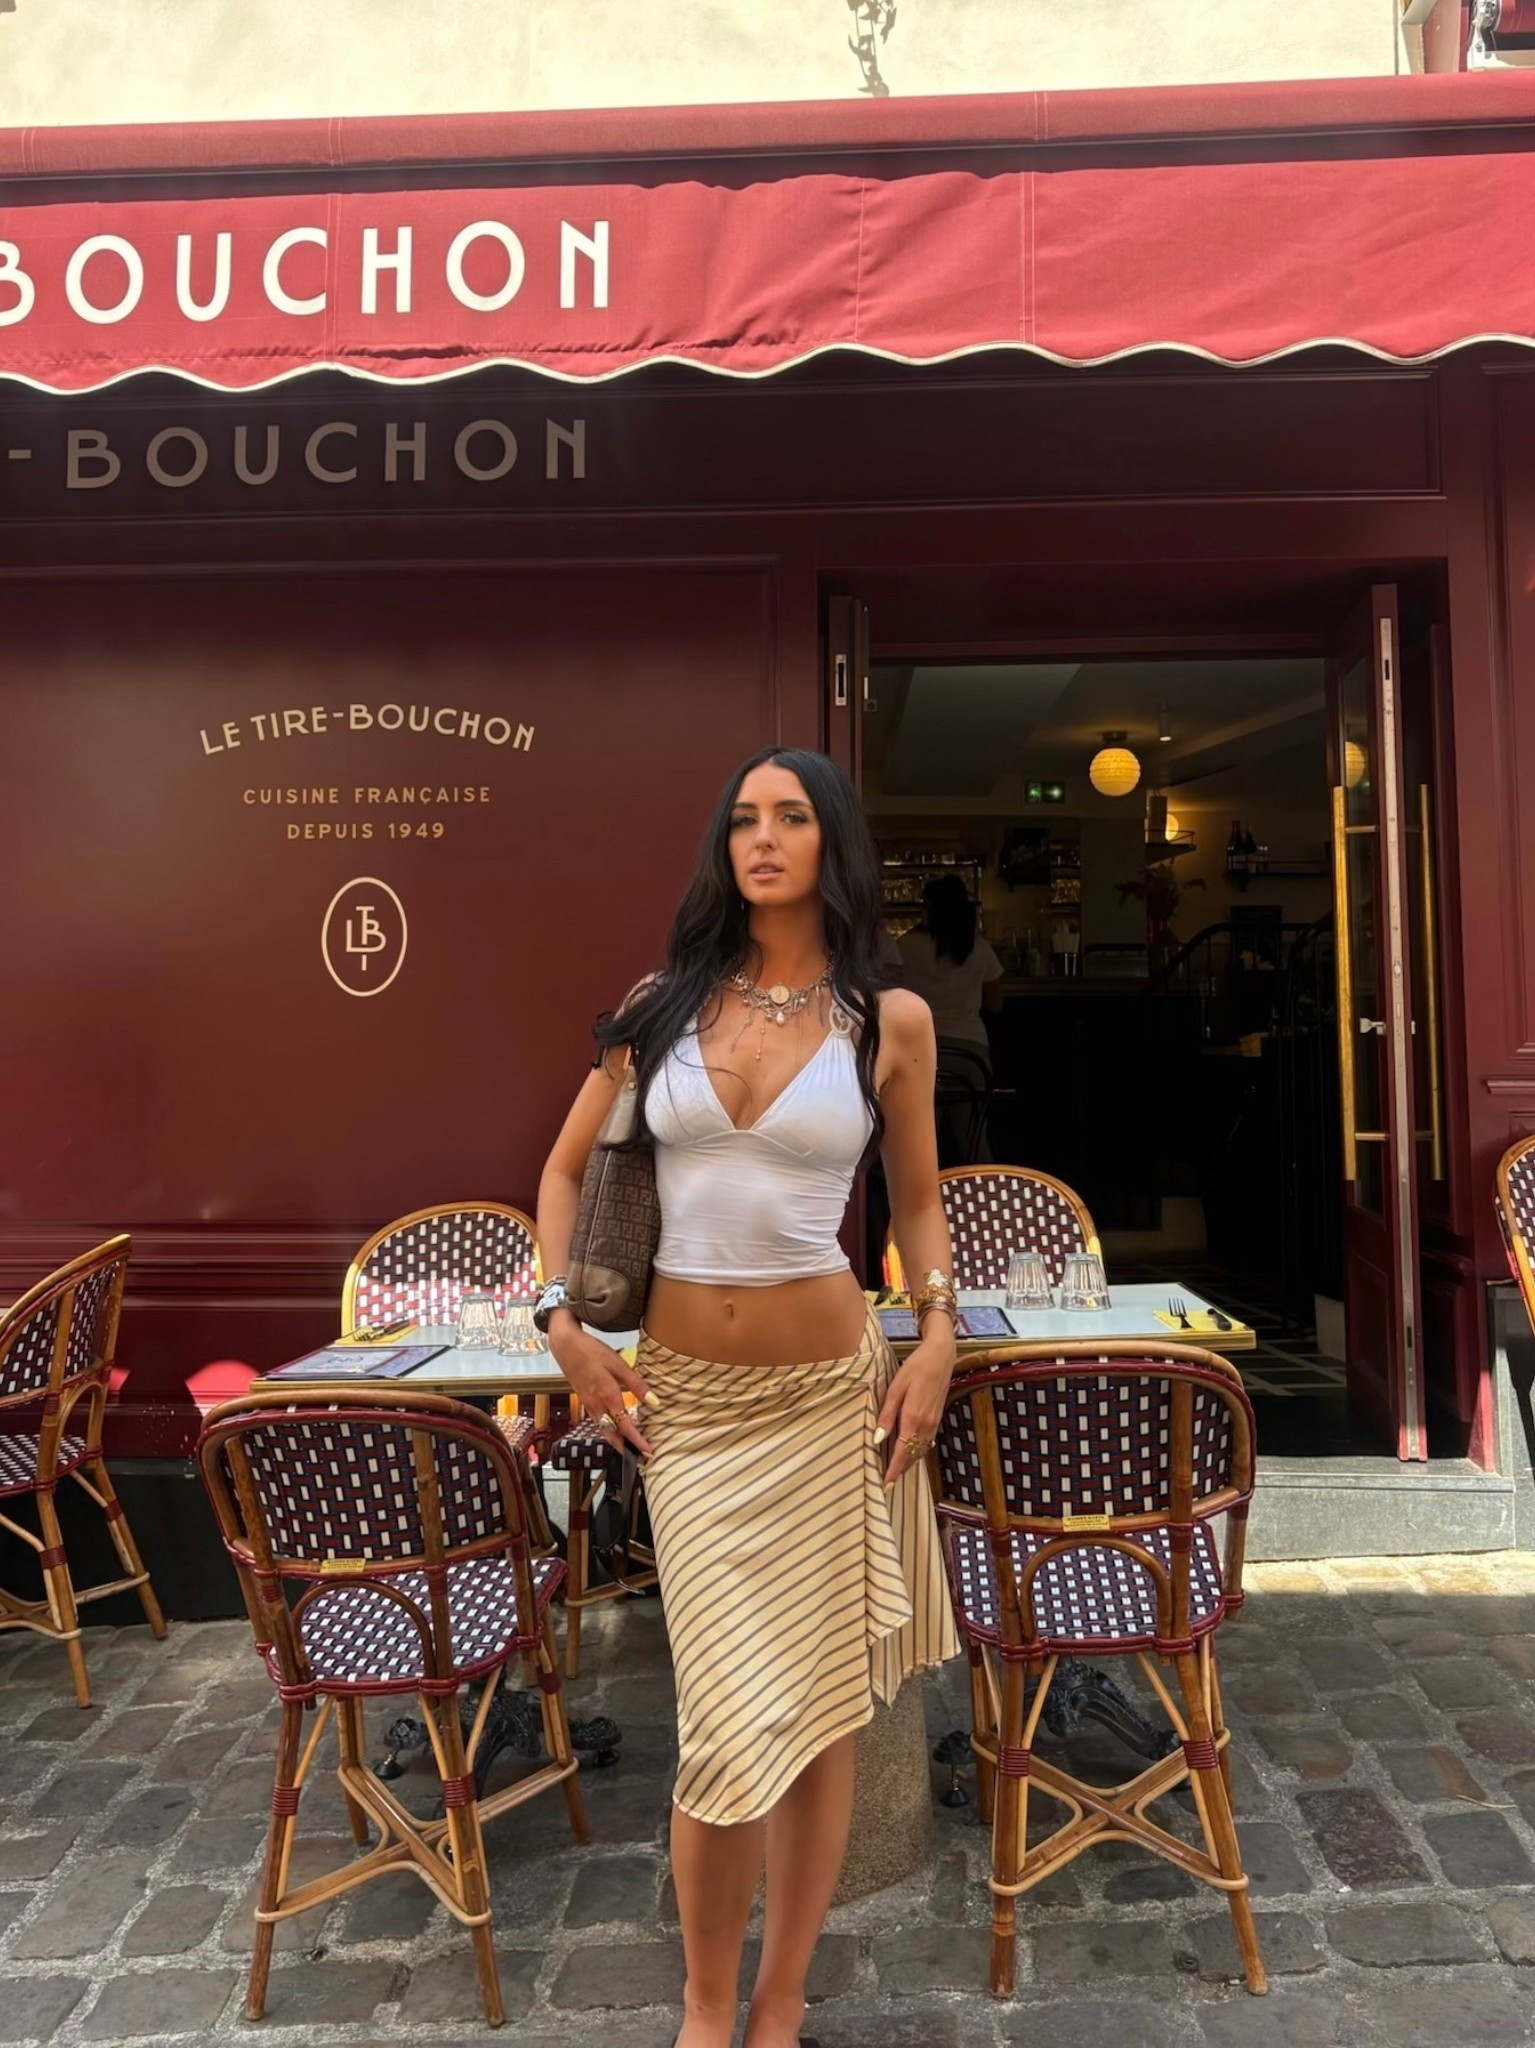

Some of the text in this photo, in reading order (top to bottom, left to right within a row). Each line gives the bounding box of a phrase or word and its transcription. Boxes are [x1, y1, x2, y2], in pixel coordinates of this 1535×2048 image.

[199, 703, 536, 755] LE TIRE-BOUCHON
[243, 786, 490, 805] CUISINE FRANÇAISE
[287, 822, 444, 840] DEPUIS 1949
